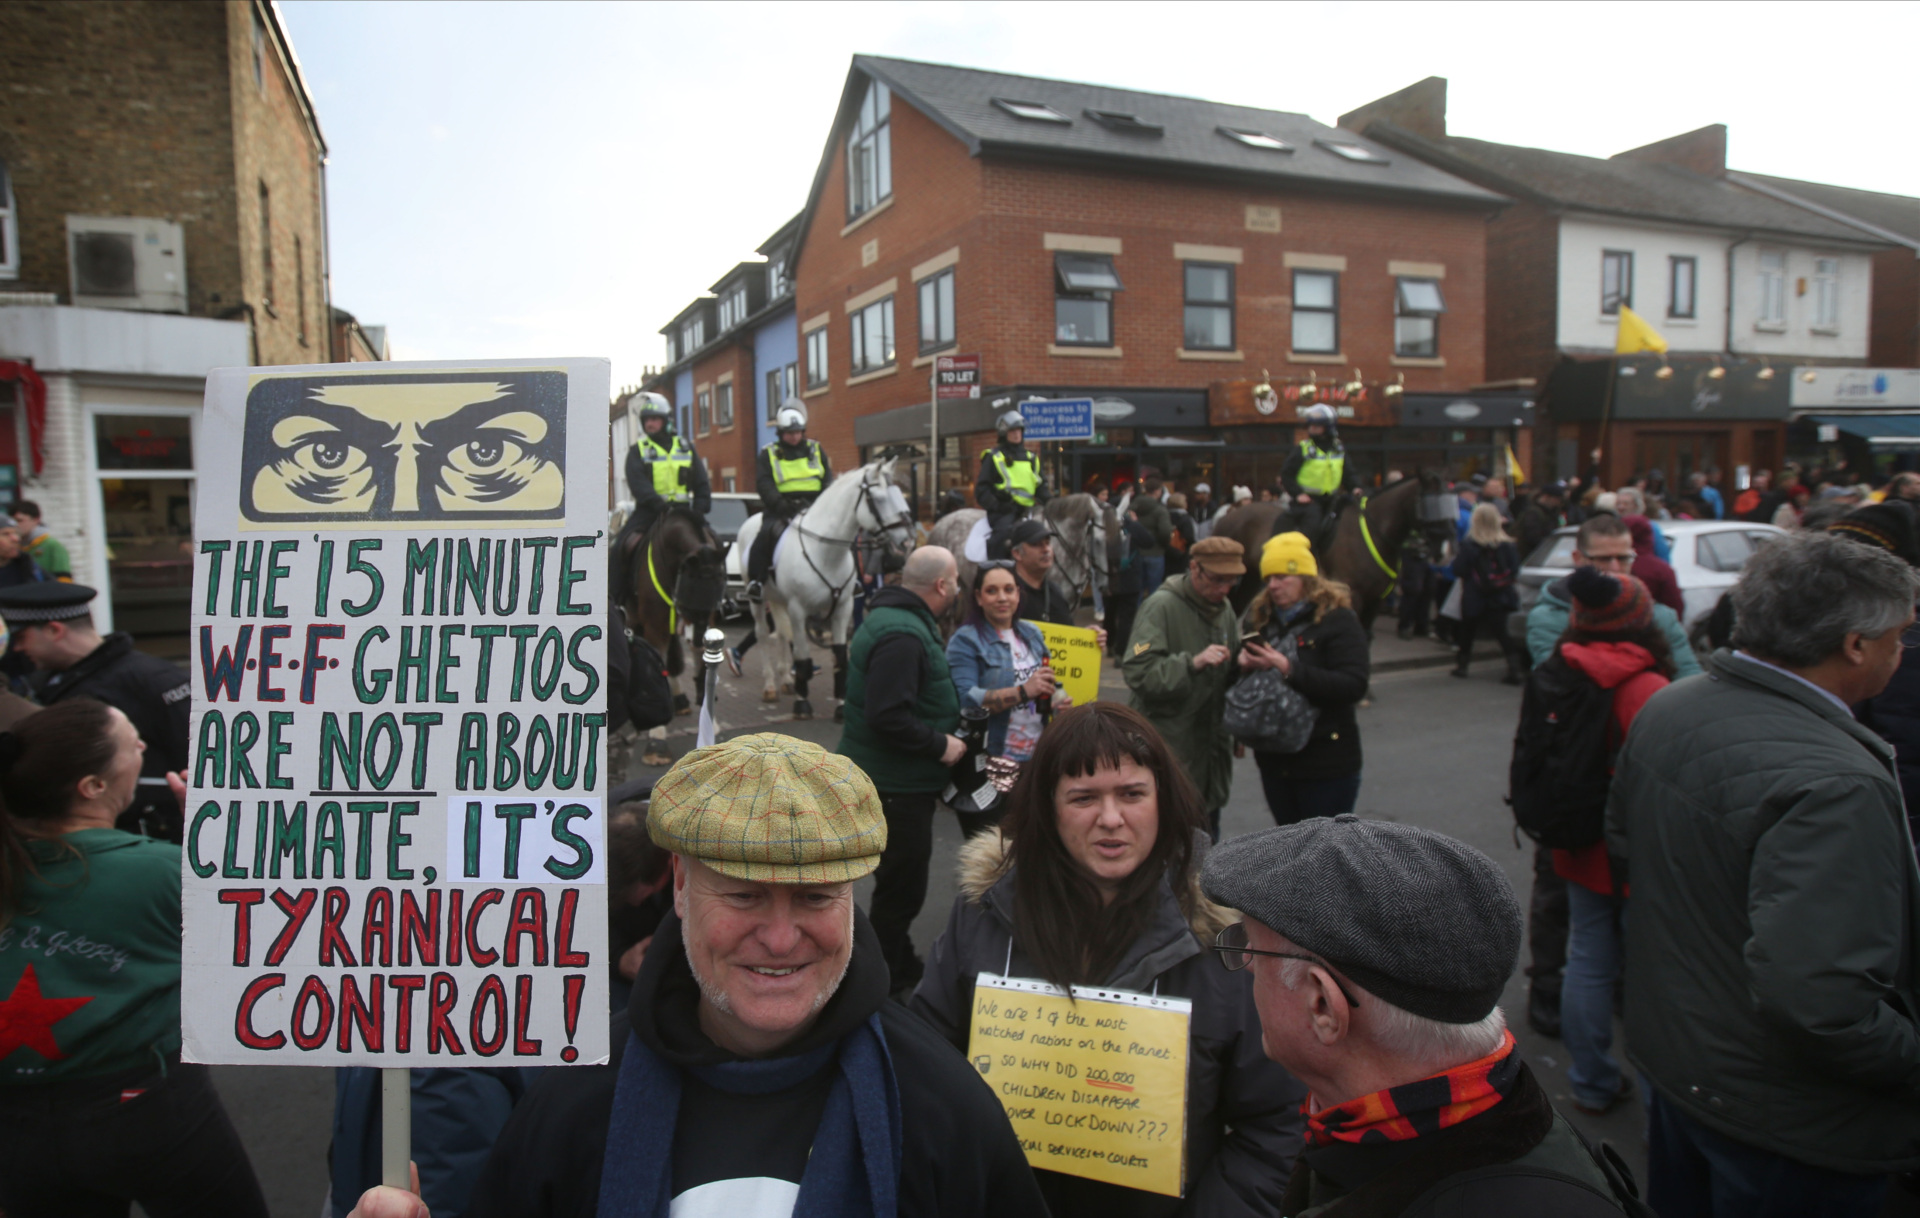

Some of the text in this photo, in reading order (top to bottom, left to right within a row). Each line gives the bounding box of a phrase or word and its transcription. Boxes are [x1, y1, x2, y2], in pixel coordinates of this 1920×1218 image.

[941, 371, 975, 383] TO LET
[1024, 404, 1088, 414] No access to
[1058, 414, 1083, 423] Road
[1024, 425, 1089, 436] except cycles
[200, 540, 299, 618] THE
[314, 533, 385, 618] '15
[1050, 635, 1067, 644] min
[1069, 638, 1094, 648] cities
[352, 624, 603, 704] GHETTOS
[1070, 667, 1083, 678] ID
[194, 710, 607, 791] ARE NOT ABOUT
[188, 799, 594, 885] CLIMATE, IT'S
[218, 886, 589, 967] TYRANICAL
[977, 997, 998, 1018] We
[1004, 1007, 1029, 1022] are
[1036, 1006, 1042, 1020] 1
[1066, 1011, 1090, 1028] the
[1096, 1018, 1128, 1031] most
[979, 1025, 1025, 1041] watched
[1031, 1033, 1073, 1048] nations
[1078, 1039, 1096, 1051] on
[1102, 1039, 1122, 1054] the
[1001, 1054, 1135, 1084] SO WHY DID 200,000
[1002, 1082, 1141, 1110] CHILDREN DISAPPEAR
[1007, 1107, 1036, 1120] OVER
[1107, 1152, 1149, 1168] COURTS
